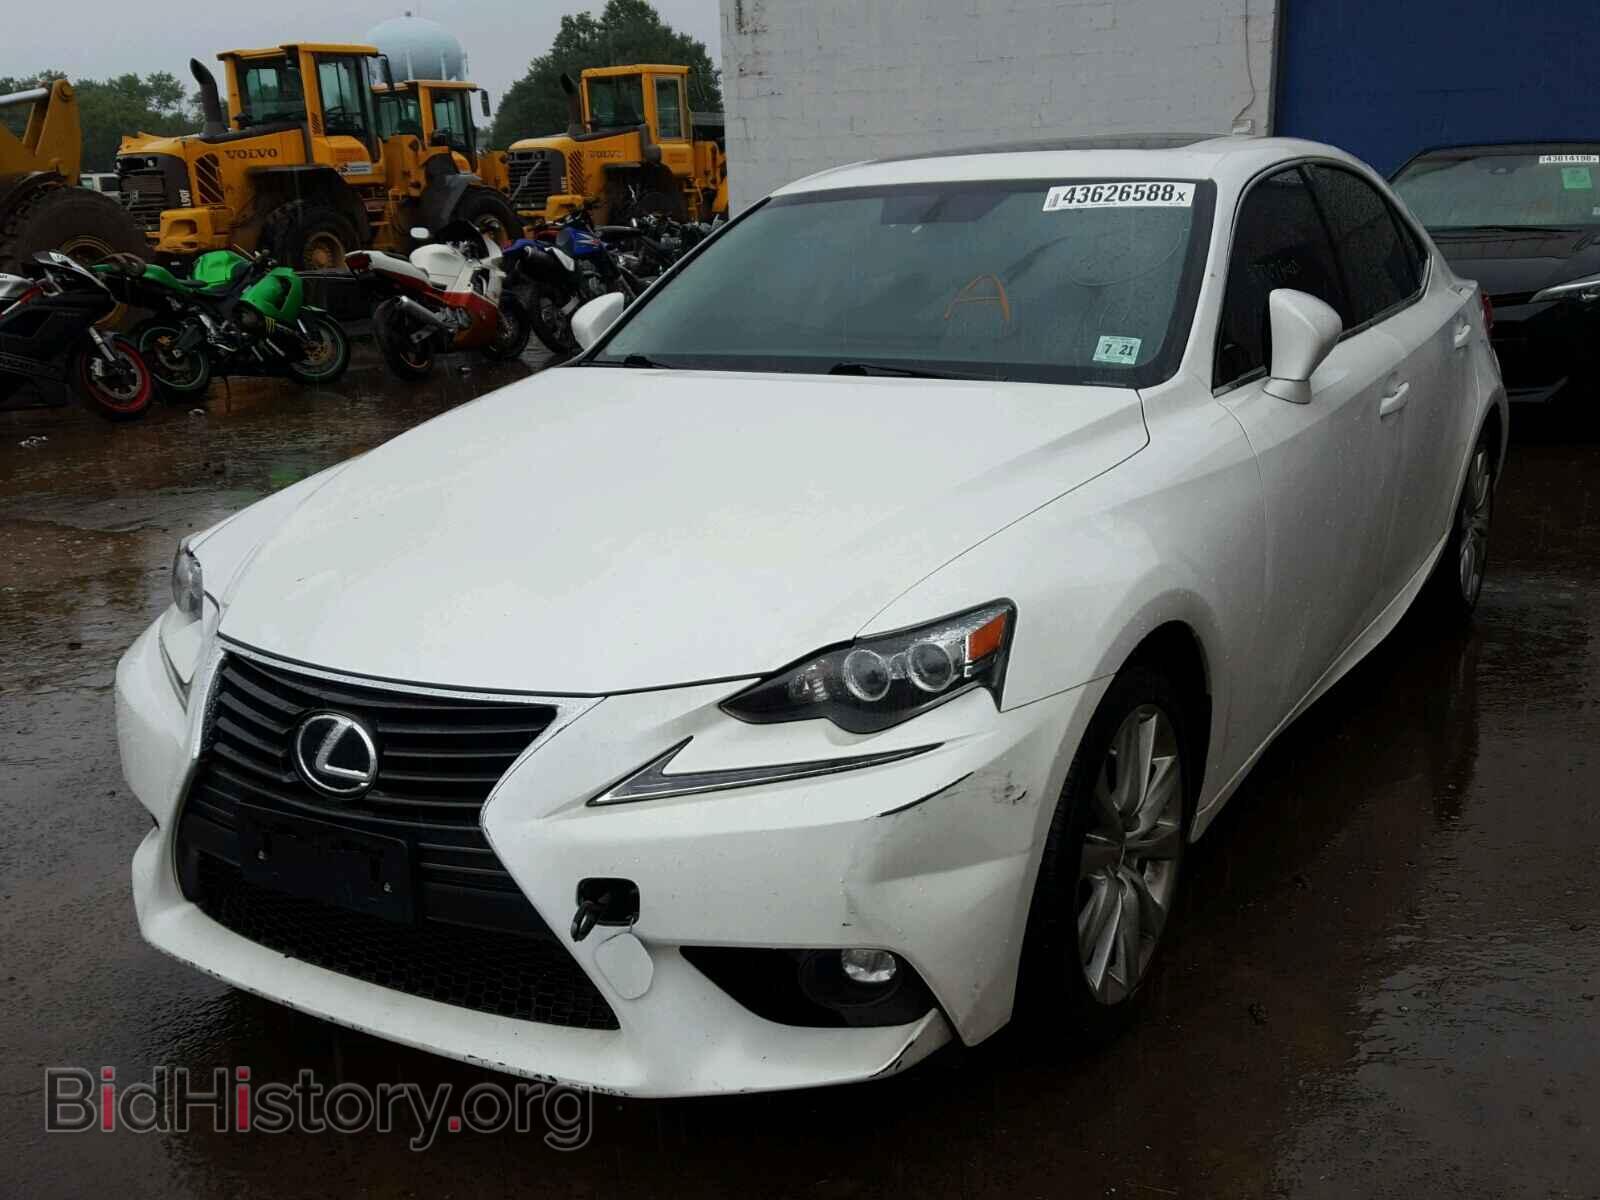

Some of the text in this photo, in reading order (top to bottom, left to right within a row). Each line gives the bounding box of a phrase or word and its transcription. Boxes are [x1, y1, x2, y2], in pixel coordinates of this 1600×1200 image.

[224, 148, 278, 159] VOLVO
[943, 272, 1010, 321] A
[1105, 344, 1134, 356] 7 21
